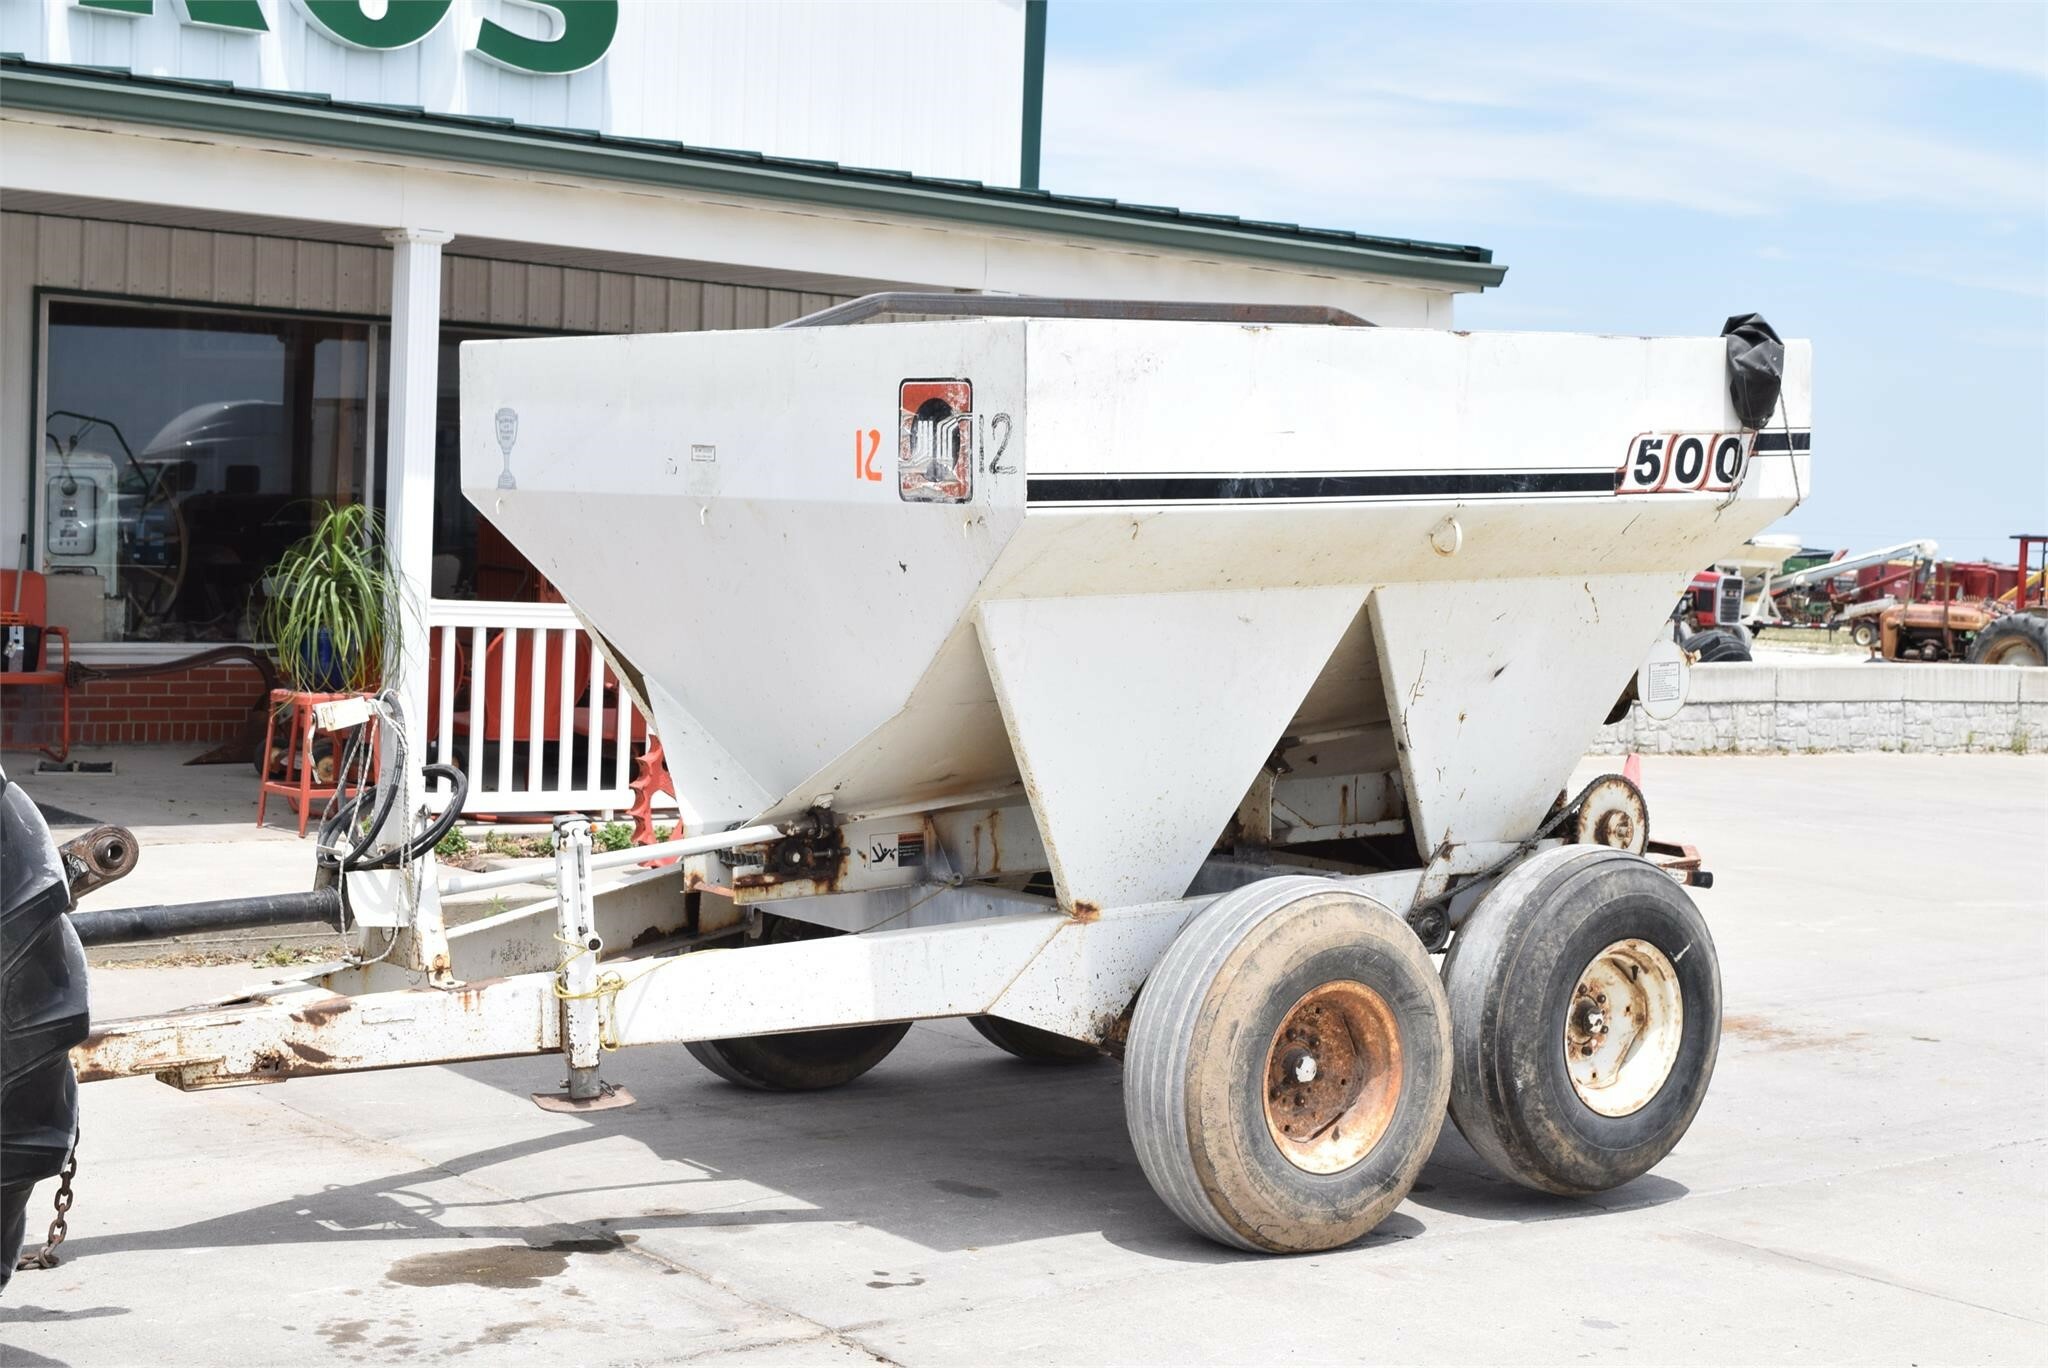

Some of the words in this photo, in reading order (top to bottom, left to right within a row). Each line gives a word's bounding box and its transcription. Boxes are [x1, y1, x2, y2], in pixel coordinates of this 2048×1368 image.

[856, 429, 882, 481] 12
[979, 413, 1017, 474] 12
[1633, 437, 1743, 486] 500
